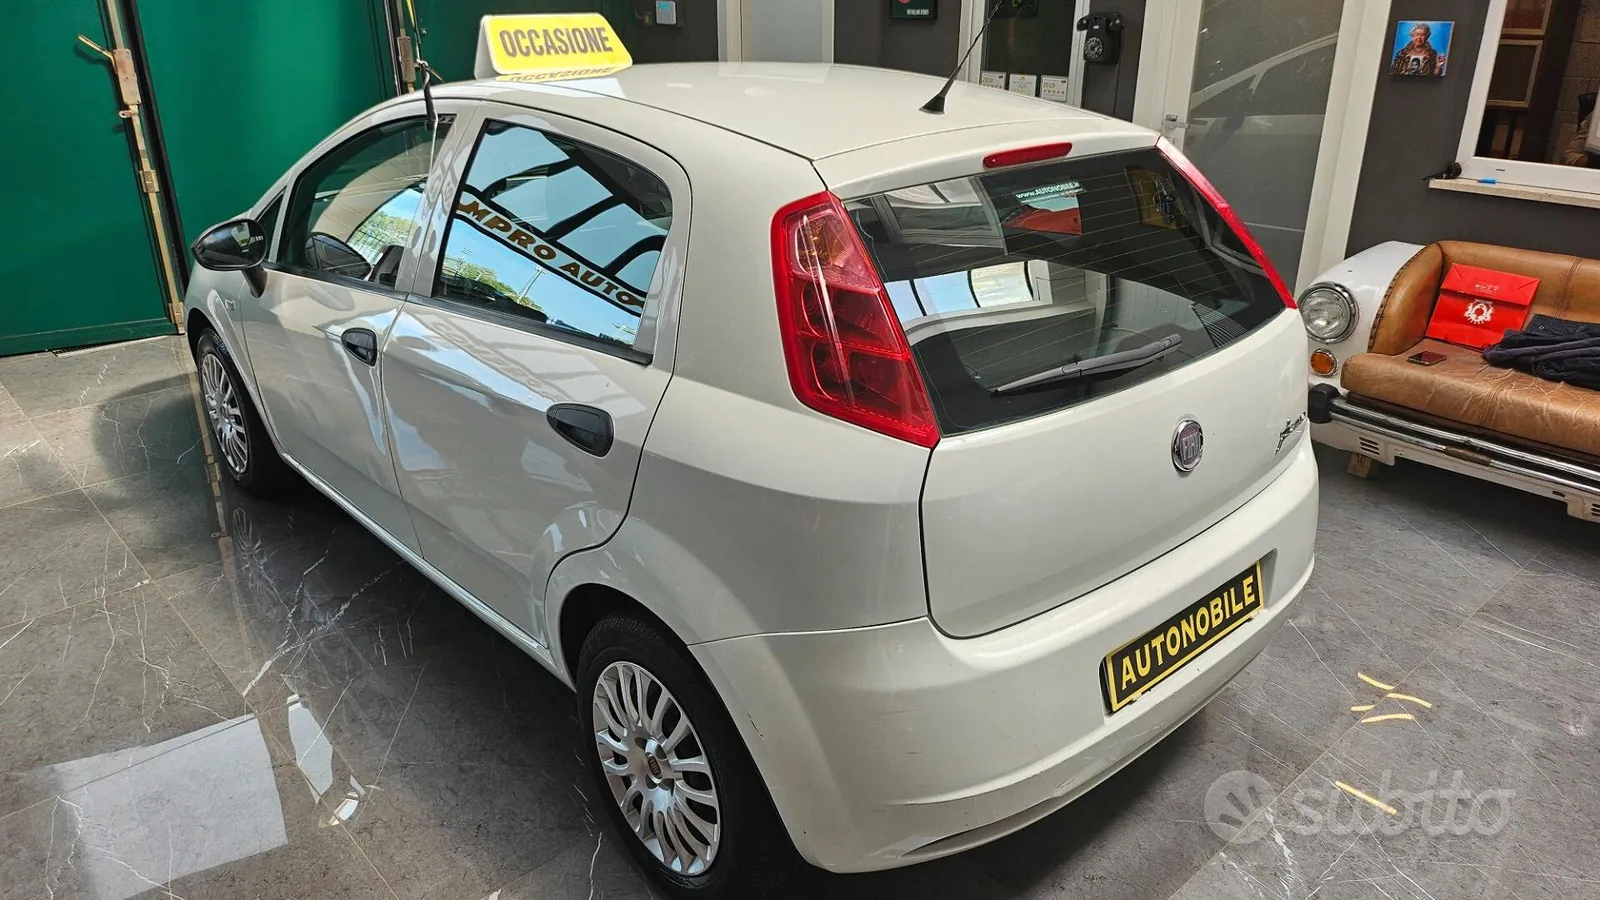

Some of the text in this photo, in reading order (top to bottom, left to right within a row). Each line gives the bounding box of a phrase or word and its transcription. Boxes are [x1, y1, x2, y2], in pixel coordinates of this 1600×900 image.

[499, 27, 613, 58] OCCASIONE
[457, 200, 645, 308] MPRO AUTO
[1121, 574, 1256, 691] AUTONOBILE
